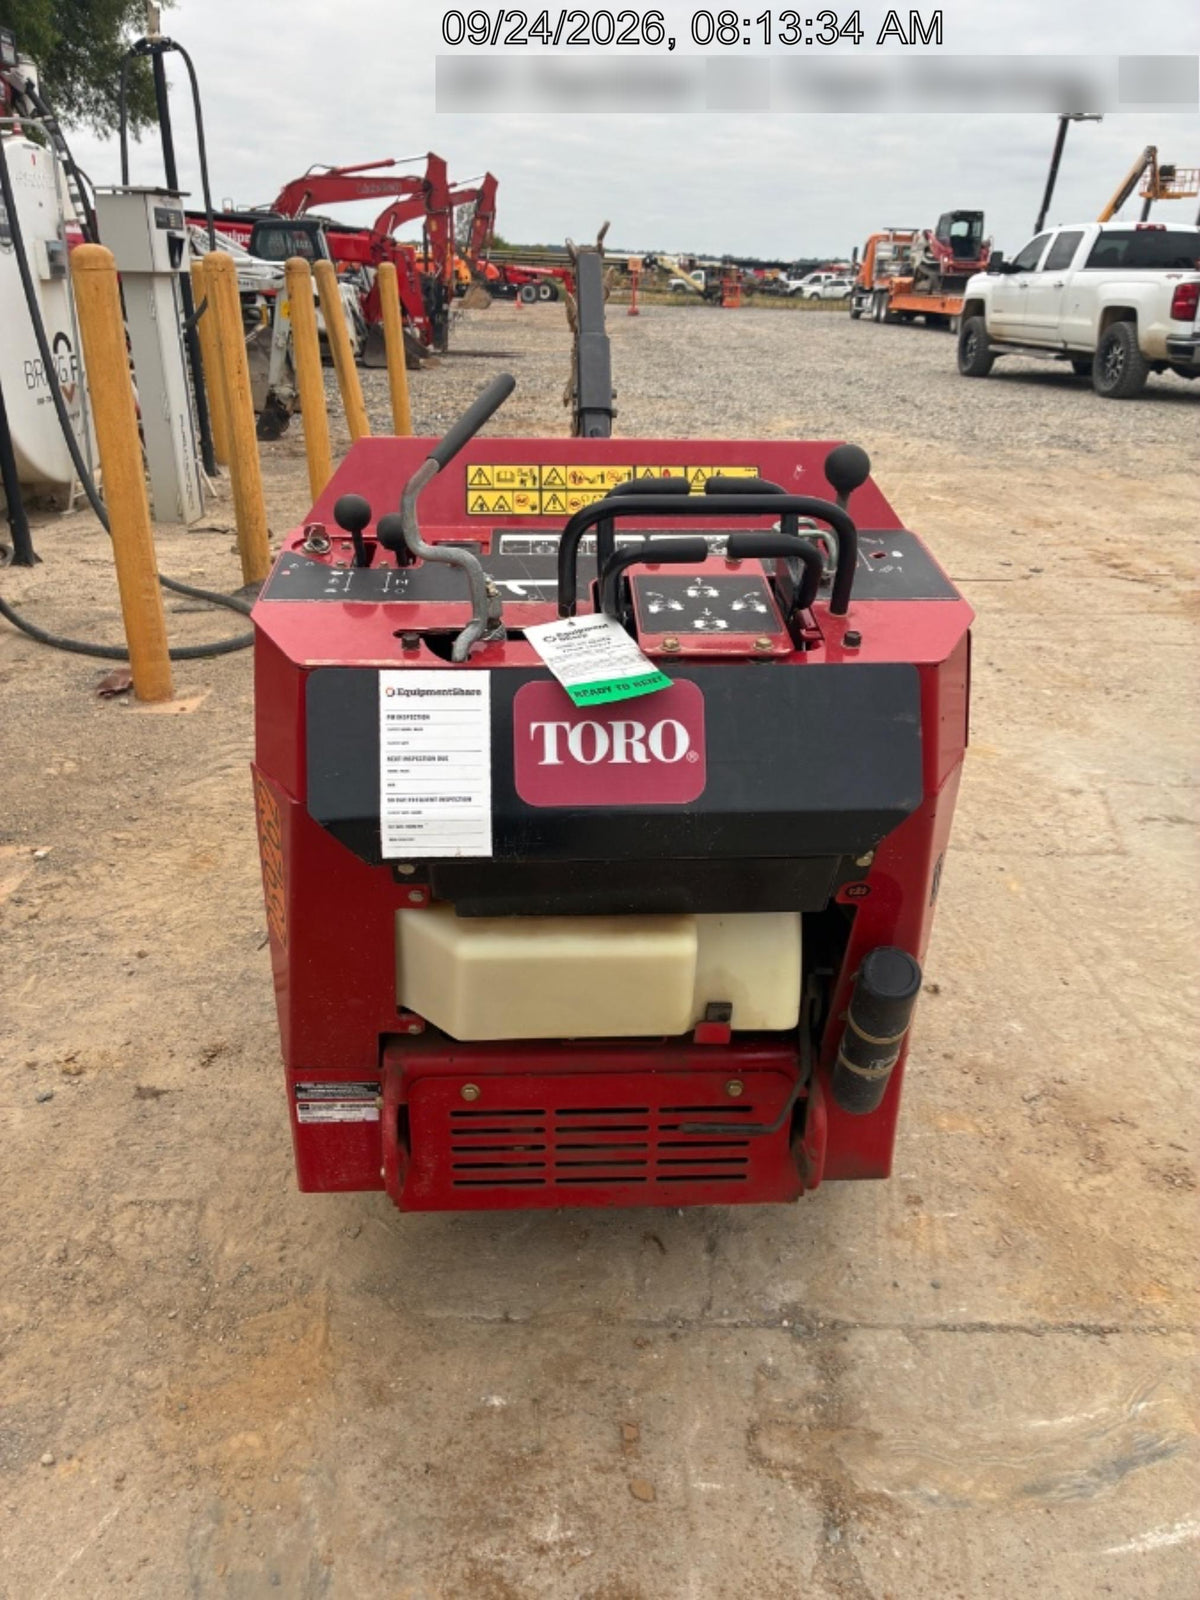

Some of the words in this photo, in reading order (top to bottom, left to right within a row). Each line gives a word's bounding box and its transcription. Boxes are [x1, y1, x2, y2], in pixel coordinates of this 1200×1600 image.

[397, 687, 482, 698] EquipmentShare
[575, 686, 612, 698] READY
[616, 684, 631, 692] TO
[634, 676, 662, 688] RENT
[396, 713, 431, 721] INSPECTION
[530, 719, 690, 765] TORO
[403, 754, 436, 762] INSPECTION
